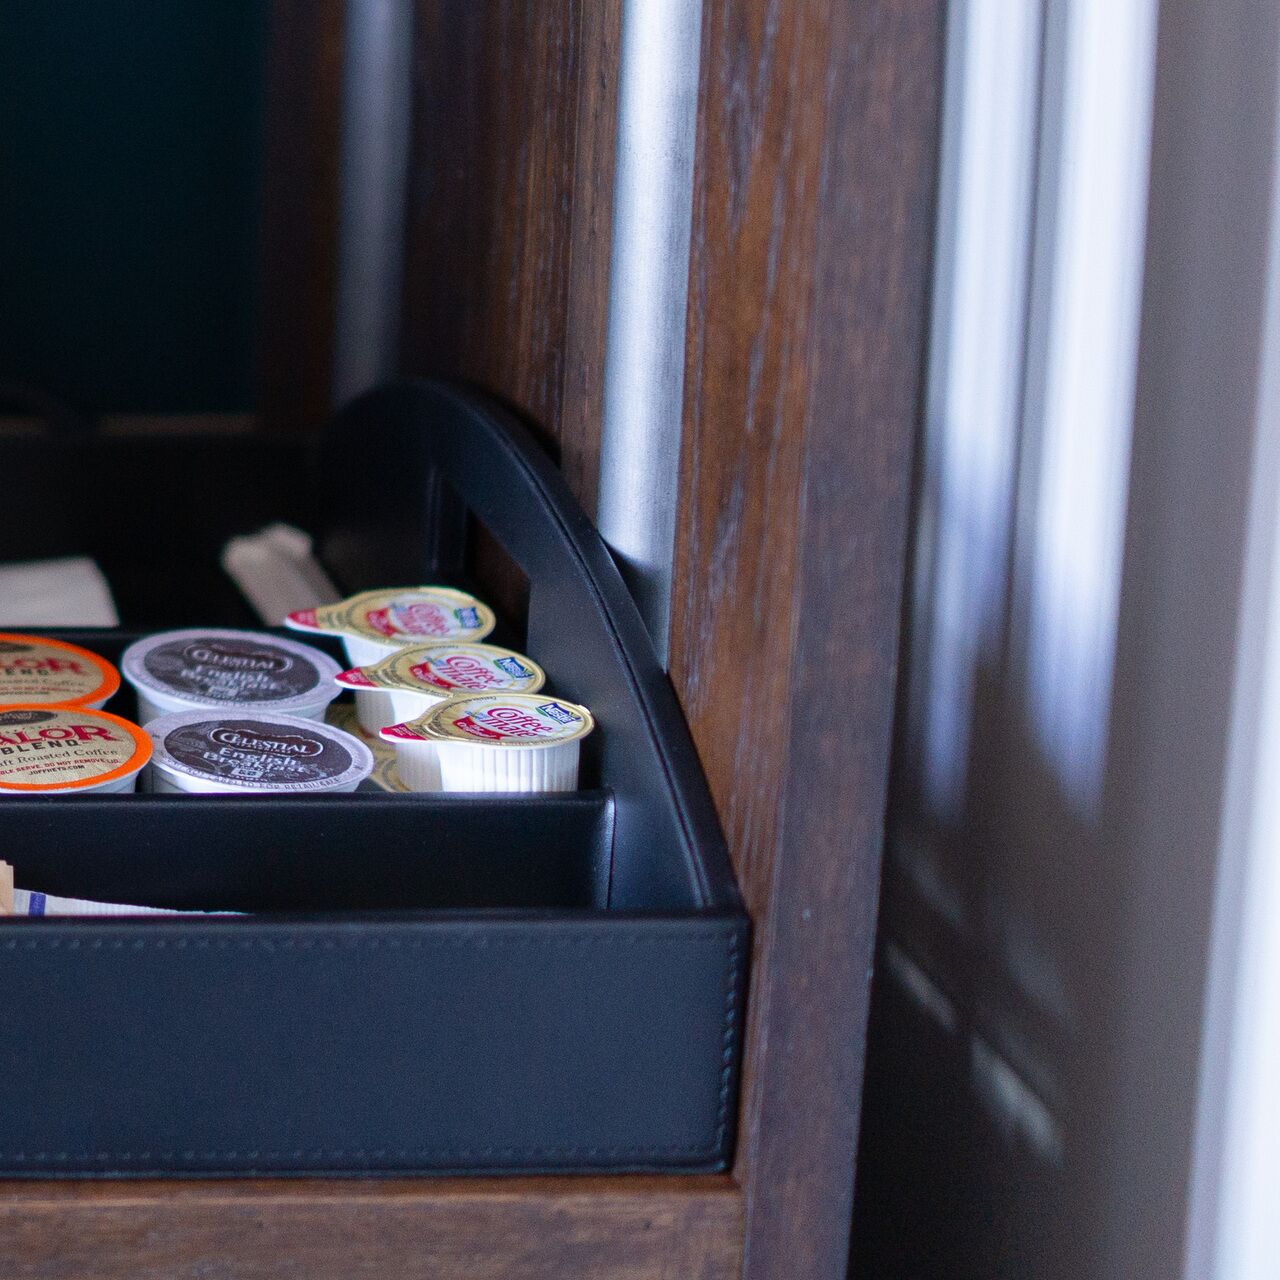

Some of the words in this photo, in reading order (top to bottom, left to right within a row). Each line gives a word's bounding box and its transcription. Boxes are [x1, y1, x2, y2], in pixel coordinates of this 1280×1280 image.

[480, 717, 537, 738] mate
[486, 707, 554, 733] Coffee
[0, 738, 82, 756] BLEND
[220, 732, 312, 754] CELESTIAL
[16, 750, 71, 765] Roasted
[73, 748, 119, 757] Coffee
